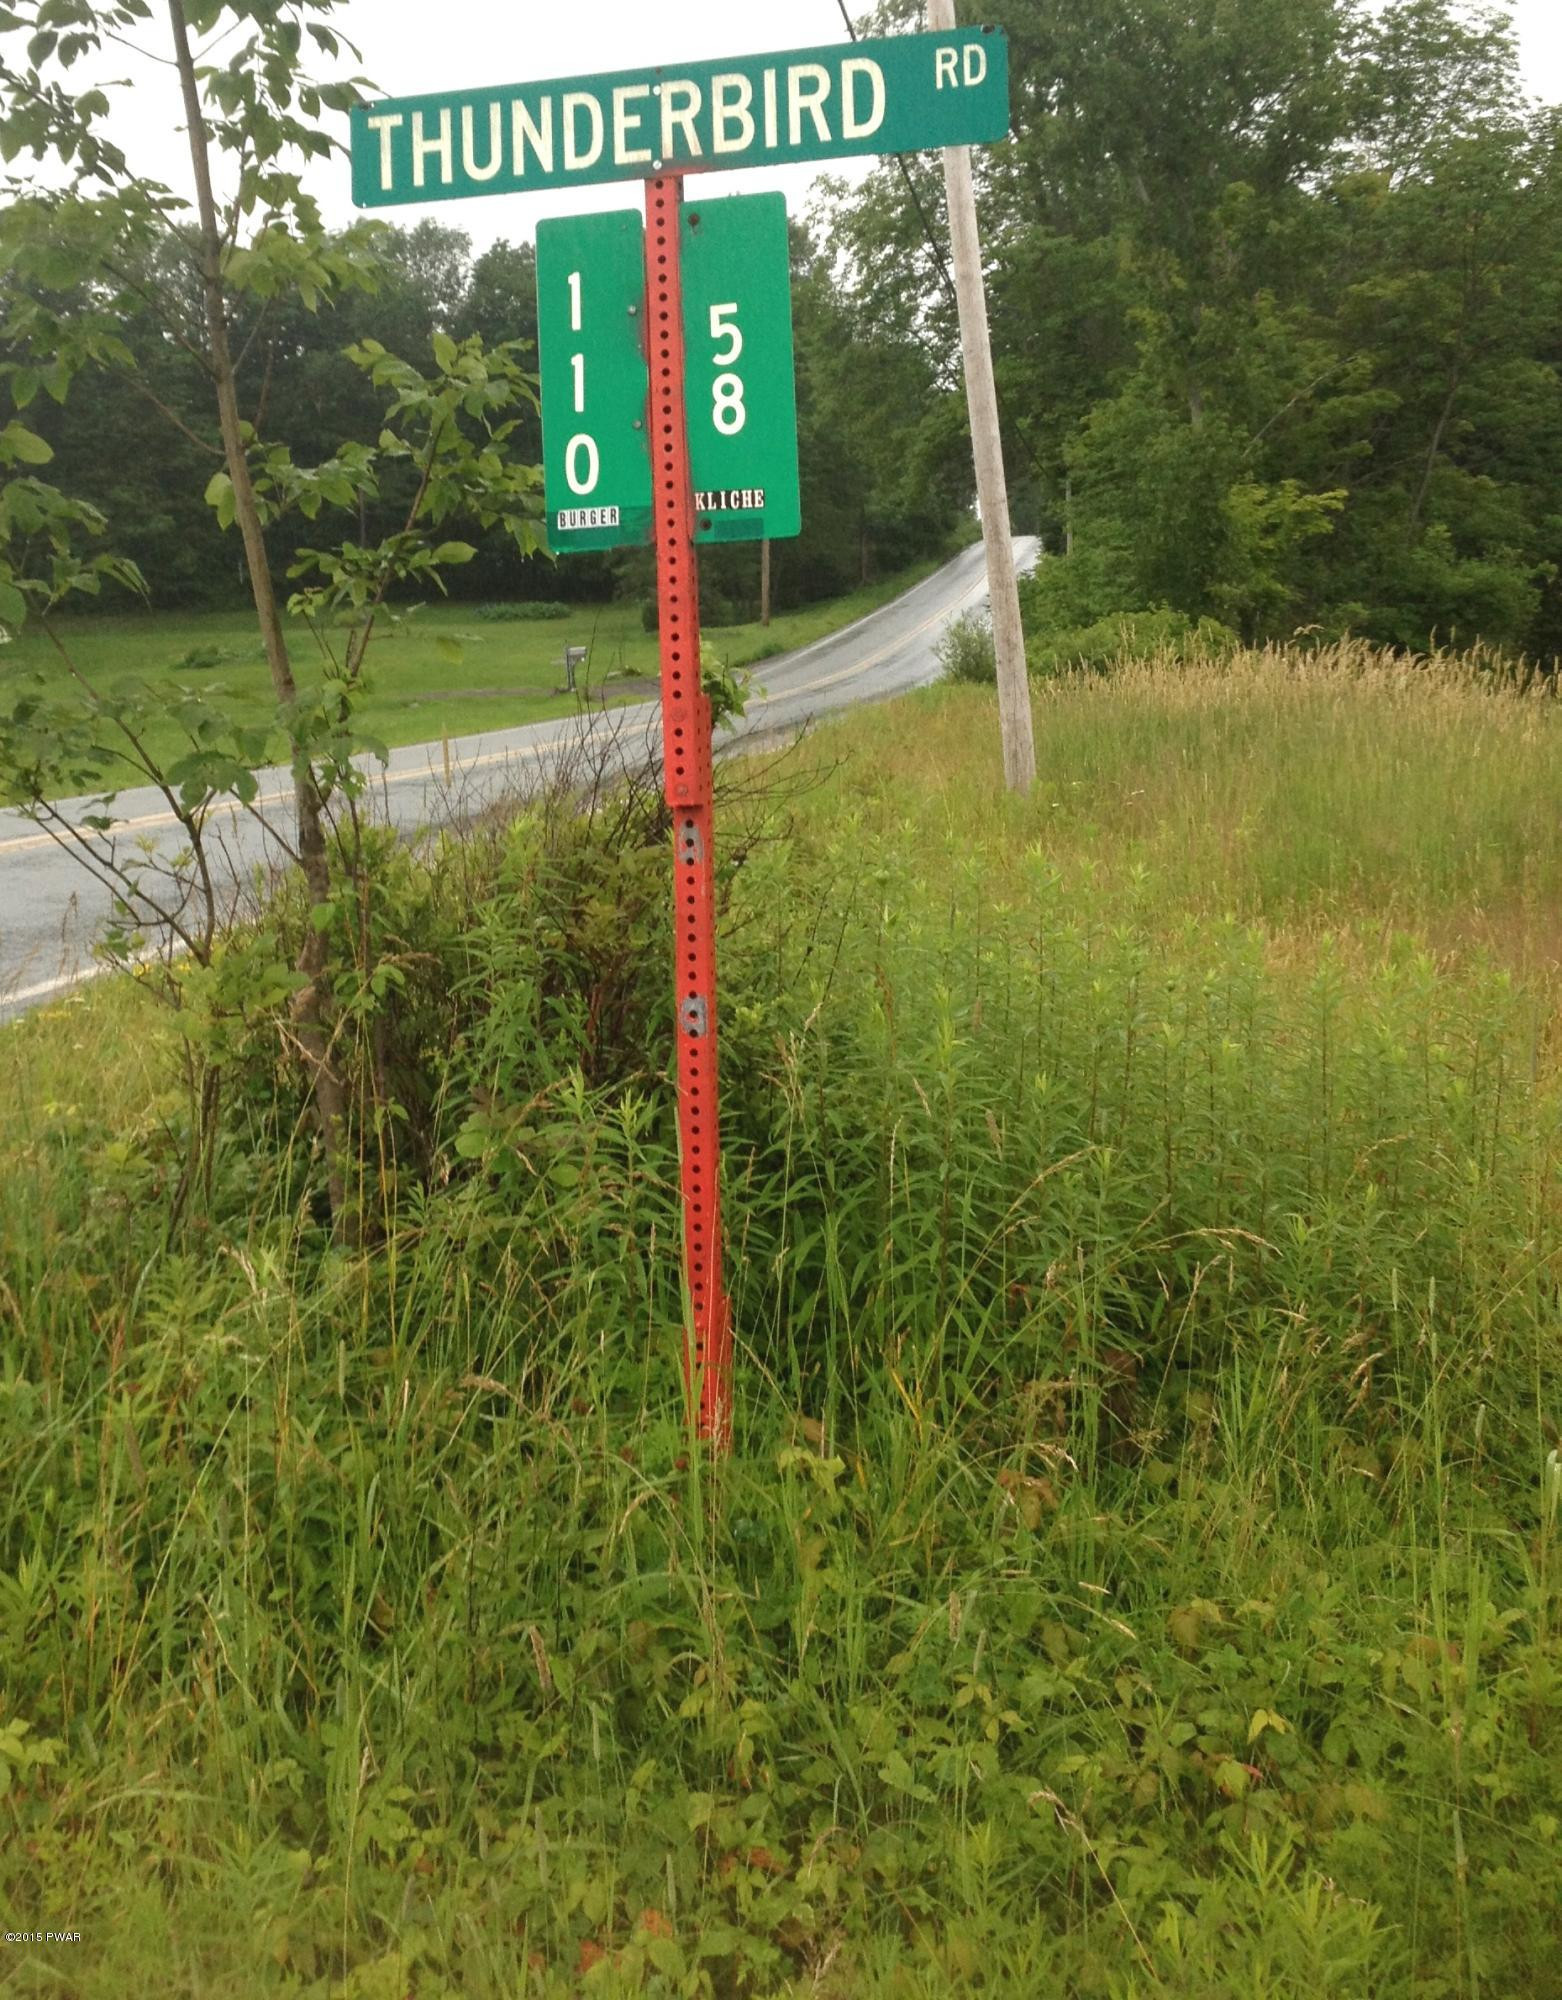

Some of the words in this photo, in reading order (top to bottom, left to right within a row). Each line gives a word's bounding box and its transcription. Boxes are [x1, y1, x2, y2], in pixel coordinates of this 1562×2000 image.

[368, 57, 886, 190] THUNDERBIRD
[935, 45, 988, 90] RD
[709, 302, 746, 436] 58
[558, 508, 618, 528] BURGER
[695, 490, 764, 510] KLICHE
